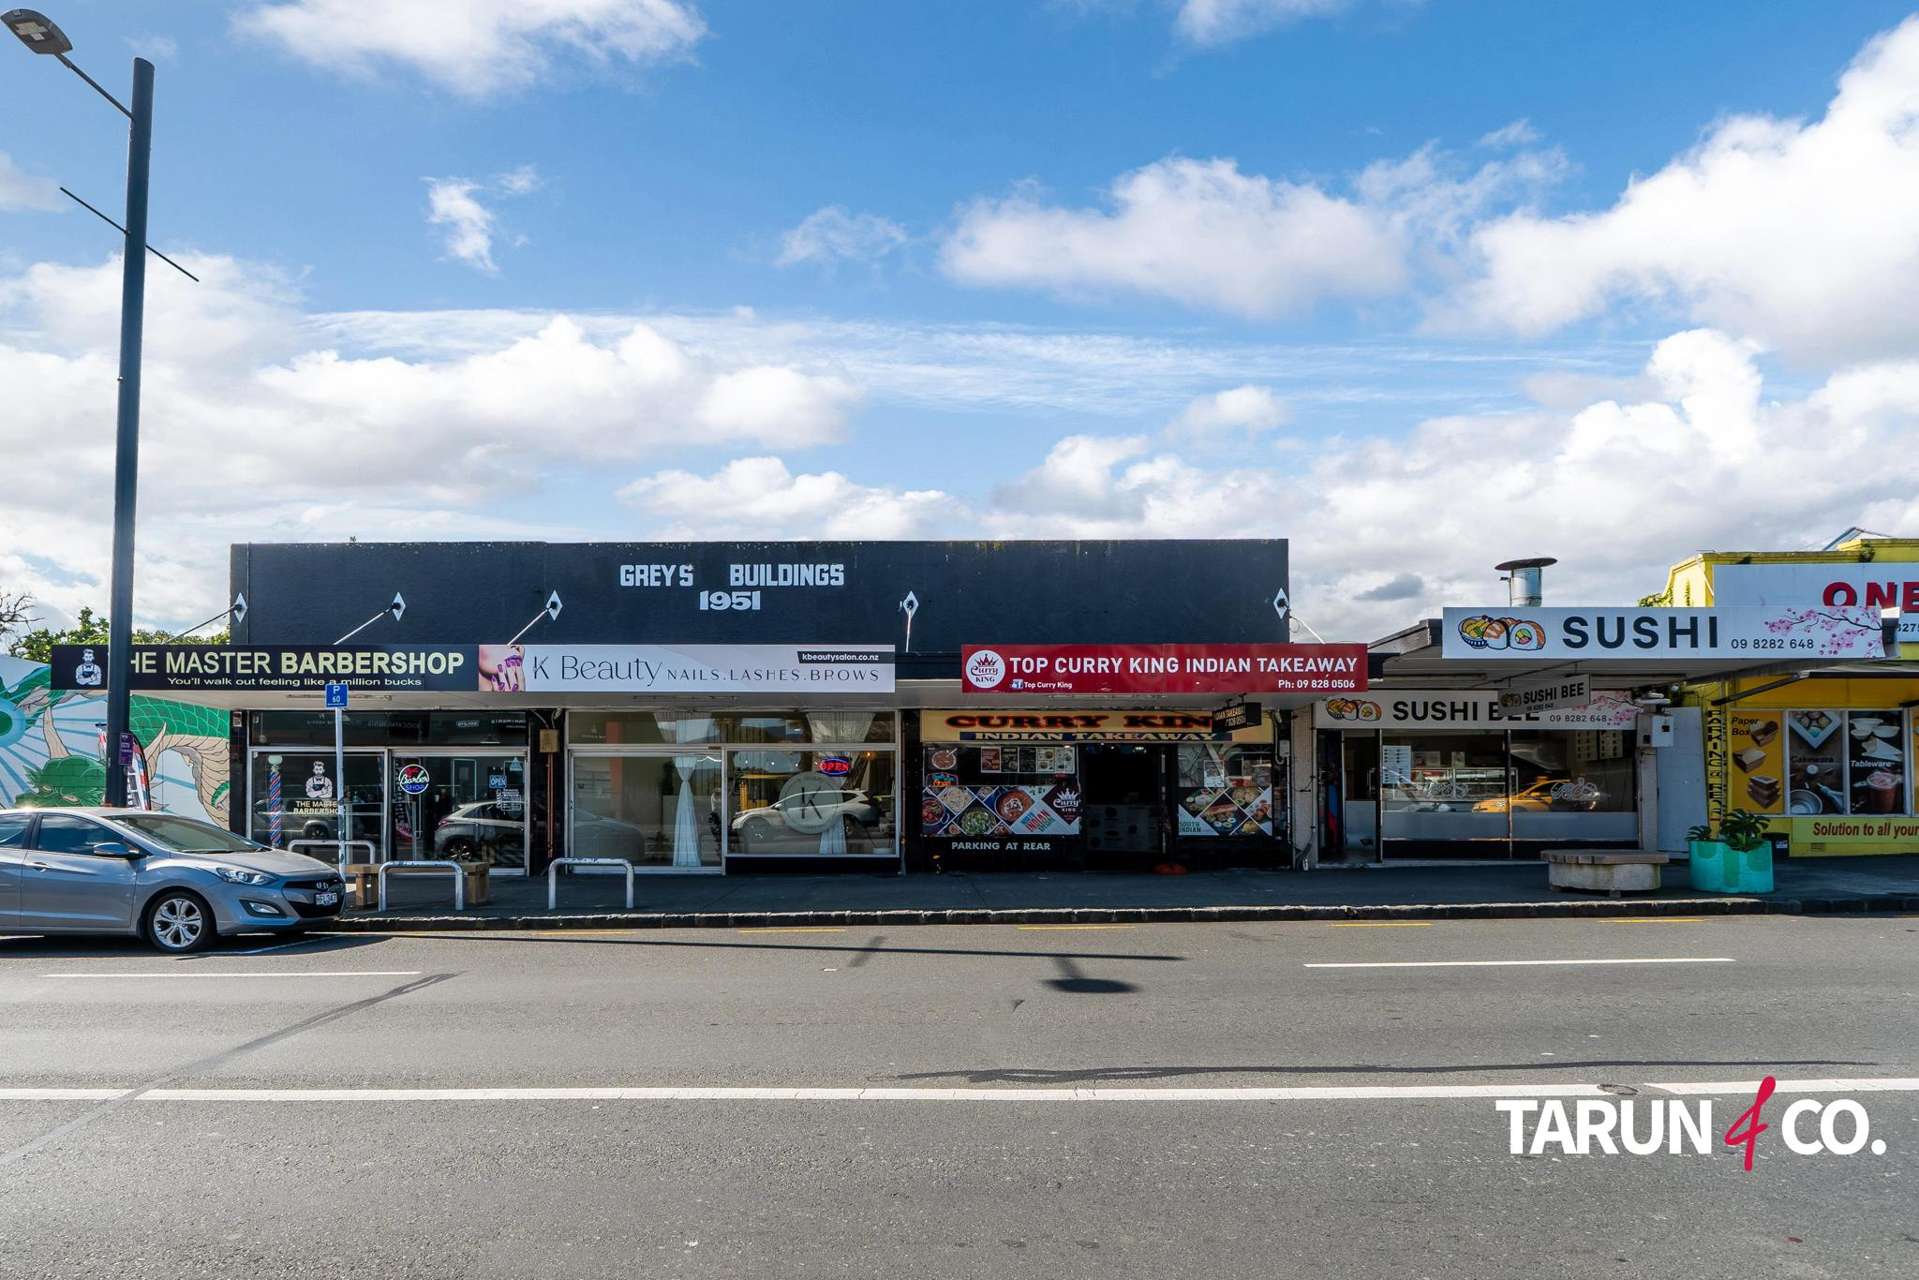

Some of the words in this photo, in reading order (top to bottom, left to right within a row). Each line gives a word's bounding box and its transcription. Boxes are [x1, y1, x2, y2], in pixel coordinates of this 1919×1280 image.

[620, 564, 694, 587] GREYS
[730, 564, 844, 587] BUILDINGS
[700, 590, 761, 610] 1951
[1562, 616, 1718, 648] SUSHI
[1731, 639, 1748, 649] 09
[1753, 639, 1784, 649] 8282
[1790, 639, 1814, 649] 648
[131, 652, 158, 674] HE
[166, 652, 271, 674] MASTER
[281, 652, 464, 674] BARBERSHOP
[802, 653, 879, 663] kbeautysalon.co.nz
[1009, 657, 1049, 673] TOP
[1055, 657, 1123, 674] CURRY
[1129, 657, 1179, 673] KING
[1186, 657, 1251, 673] INDIAN
[1257, 657, 1358, 673] TAKEAWAY
[533, 655, 550, 680] K
[561, 655, 663, 687] Beauty
[971, 666, 998, 676] Curry
[168, 677, 201, 686] You'll
[204, 677, 232, 686] walk
[236, 678, 256, 686] out
[259, 677, 301, 688] feeling
[304, 677, 325, 686] like
[341, 677, 381, 686] million
[384, 677, 423, 686] bucks
[1024, 681, 1036, 690] Top
[1037, 681, 1056, 690] Curry
[1057, 681, 1073, 690] King
[1278, 680, 1295, 689] Ph:
[1296, 680, 1309, 689] 09
[1311, 680, 1330, 689] 828
[1331, 680, 1356, 689] 0506
[333, 685, 341, 694] P
[1523, 687, 1557, 704] SUSHI
[1561, 682, 1584, 698] BEE
[1392, 701, 1478, 721] SUSHI
[1565, 714, 1586, 722] 8282
[1590, 714, 1608, 722] 648
[946, 715, 1109, 728] CURRY
[1124, 715, 1213, 728] KIN
[1732, 717, 1760, 726] Paper
[975, 732, 1064, 741] INDIAN
[1072, 732, 1217, 741] TAKEAWAY
[1731, 728, 1751, 736] Box
[820, 761, 849, 771] OPEN
[1850, 760, 1892, 768] Tableware
[295, 800, 311, 808] THE
[312, 800, 338, 808] MASTE
[801, 786, 823, 820] K
[1053, 798, 1081, 808] Curry
[1813, 822, 1859, 837] Solution
[1863, 823, 1874, 837] to
[1877, 822, 1891, 836] all
[1893, 825, 1919, 839] your
[951, 842, 1000, 850] PARKING
[1005, 842, 1019, 850] AT
[1023, 842, 1051, 850] REAR
